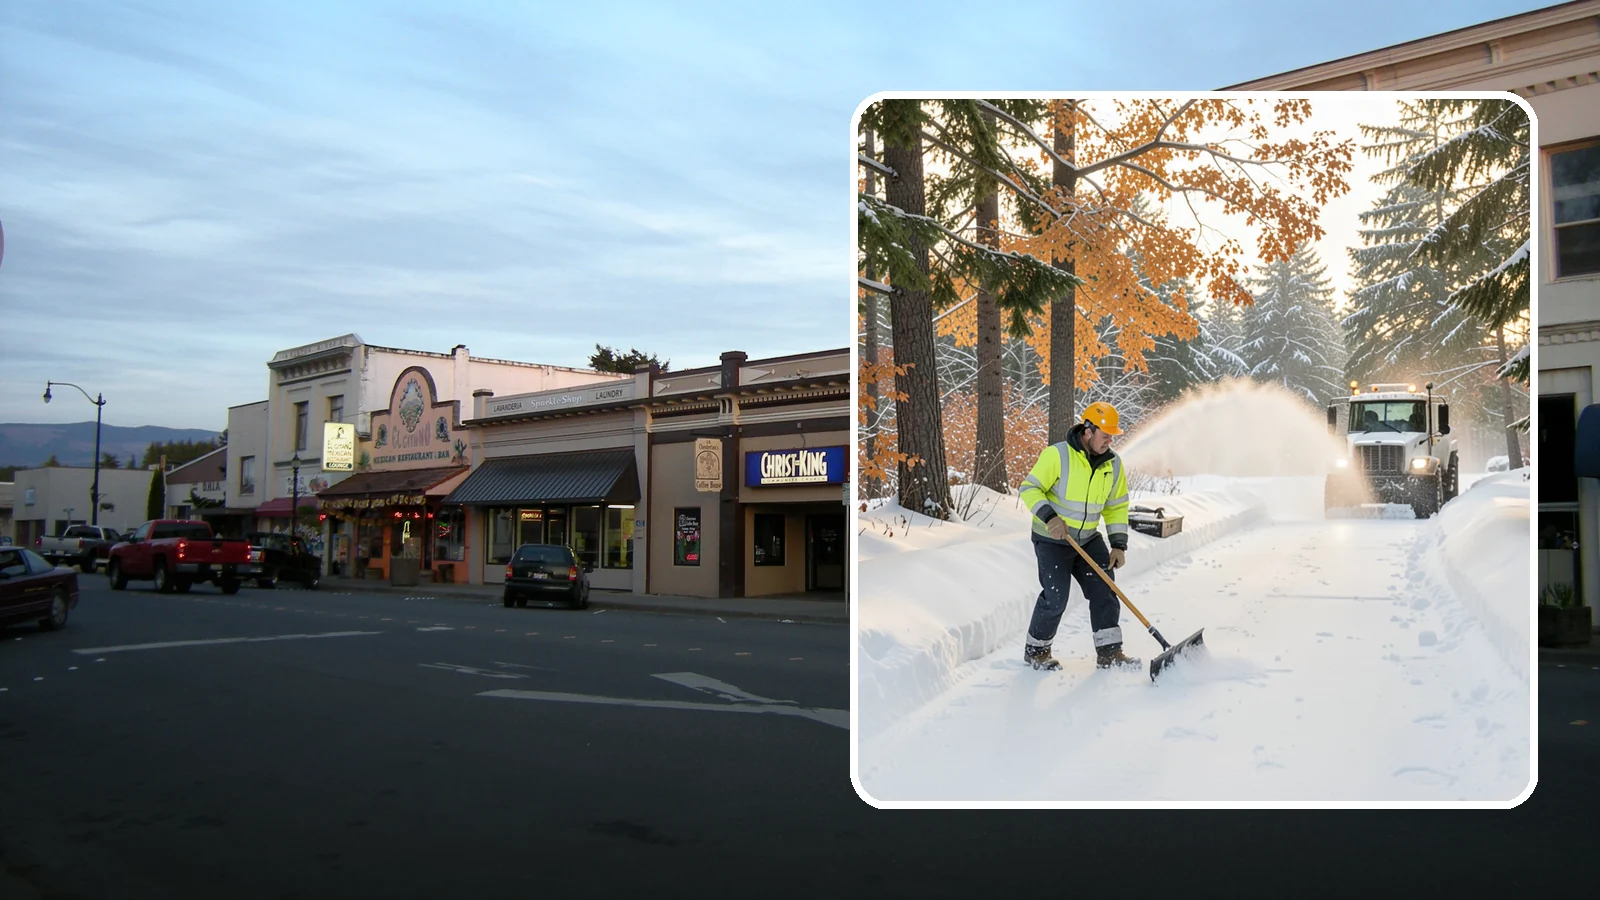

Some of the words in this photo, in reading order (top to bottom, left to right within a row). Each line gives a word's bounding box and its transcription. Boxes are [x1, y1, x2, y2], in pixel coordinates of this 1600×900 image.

[595, 389, 624, 400] LAUNDRY
[493, 402, 522, 412] LAVANDERIA
[530, 396, 560, 410] Sparkle
[561, 394, 583, 405] Shop
[373, 454, 396, 464] MEXICAN
[397, 451, 433, 463] RESTAURANT
[437, 450, 450, 459] BAR
[761, 452, 797, 478] CHRIST
[799, 450, 827, 476] KING
